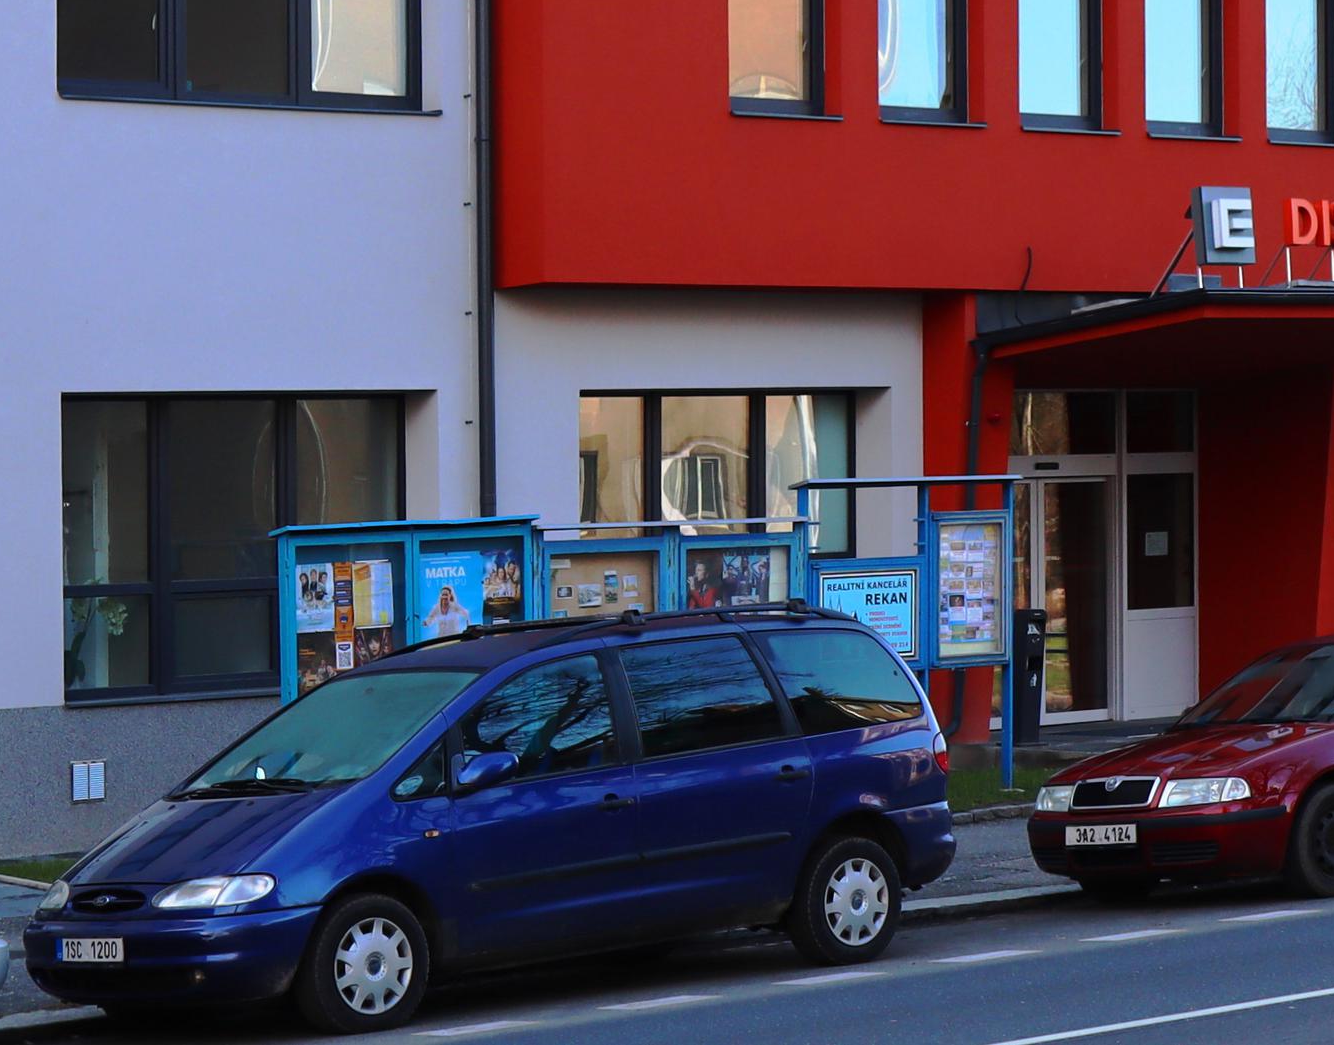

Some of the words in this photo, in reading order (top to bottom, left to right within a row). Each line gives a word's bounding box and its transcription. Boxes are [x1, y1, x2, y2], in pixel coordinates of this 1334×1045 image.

[425, 566, 466, 578] MATKA
[827, 580, 865, 592] REALITNÍ
[867, 578, 908, 589] KANCELÁŘ
[865, 592, 908, 605] REKAN
[1076, 828, 1096, 843] 3A2
[1104, 826, 1131, 842] 4124
[65, 941, 82, 959] 1SC
